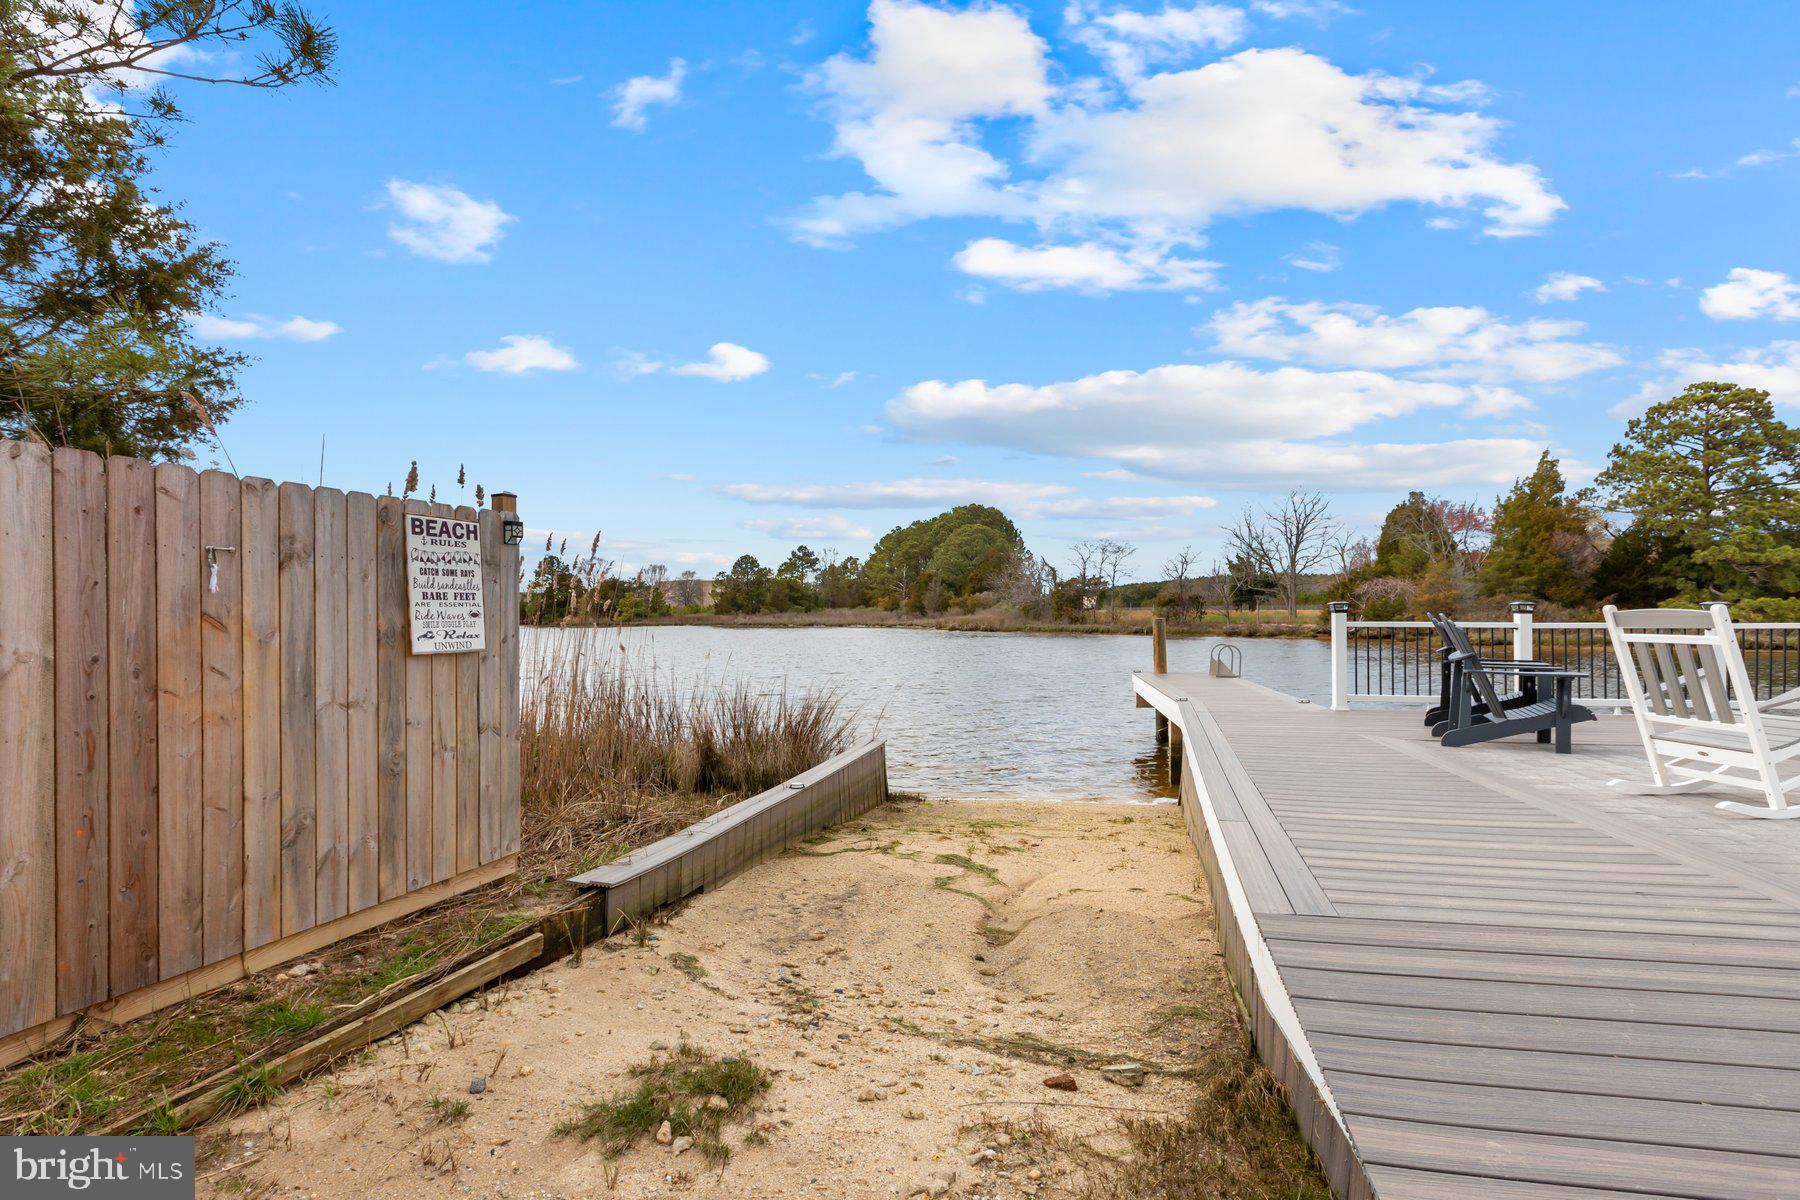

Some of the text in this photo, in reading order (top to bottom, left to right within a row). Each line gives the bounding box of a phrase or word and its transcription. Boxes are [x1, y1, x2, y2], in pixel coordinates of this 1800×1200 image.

[410, 517, 478, 541] BEACH
[430, 538, 467, 548] RULES
[419, 567, 475, 578] CATCH SOME RAYS
[412, 576, 480, 591] Build sandcastles
[421, 591, 477, 601] BARE FEET
[414, 608, 465, 621] Ride Waves
[435, 629, 481, 640] Relax
[433, 640, 473, 651] UNWIND
